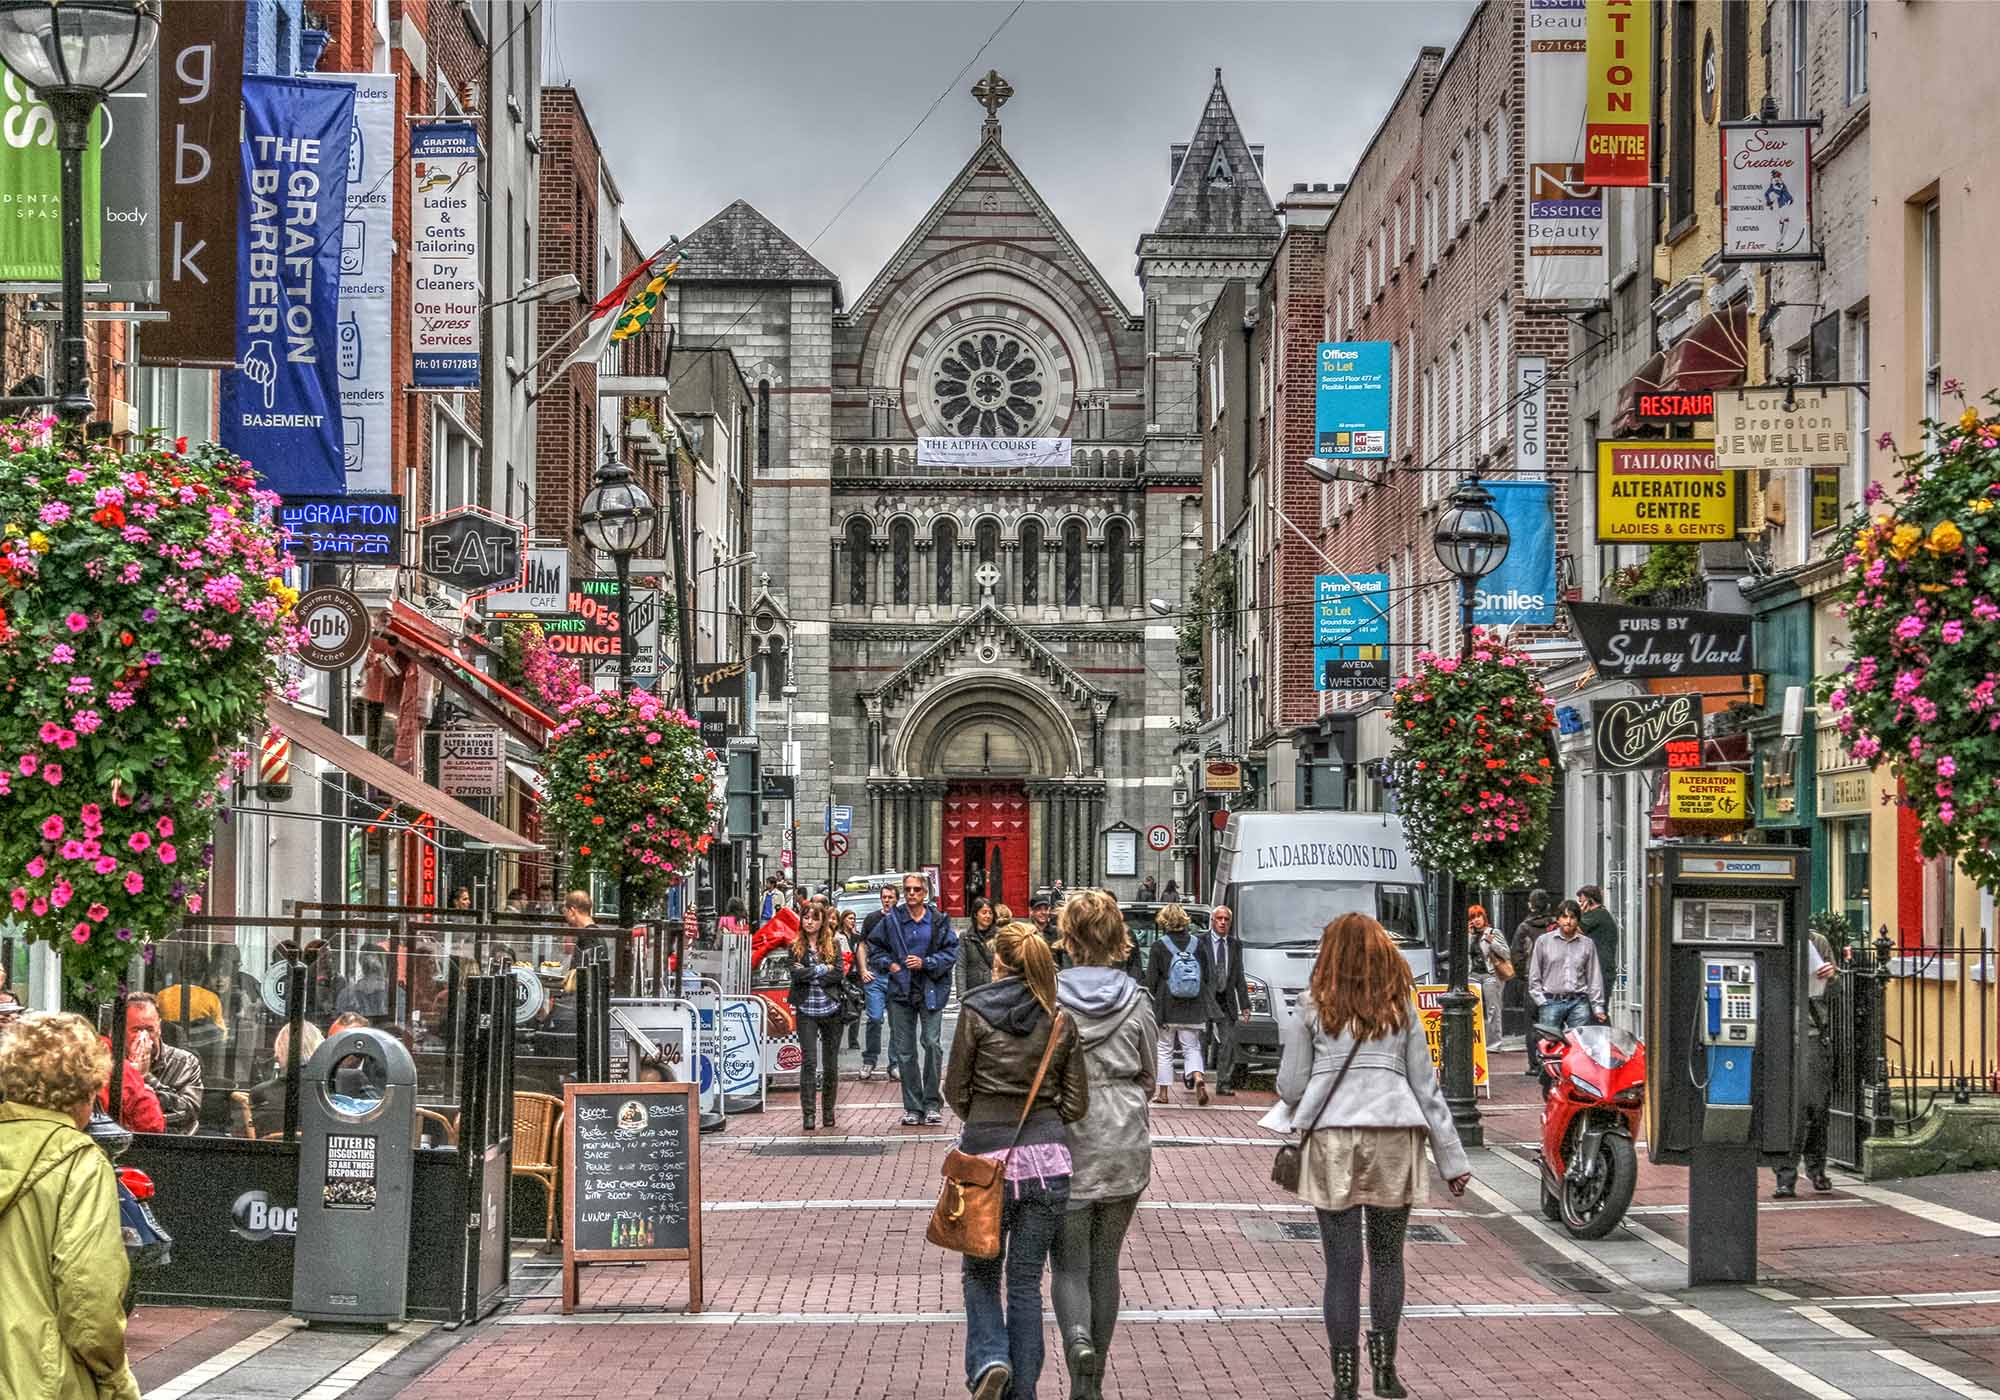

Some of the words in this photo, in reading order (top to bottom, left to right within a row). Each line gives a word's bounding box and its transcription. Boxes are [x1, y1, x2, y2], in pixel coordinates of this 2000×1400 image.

[1606, 0, 1632, 112] TION
[423, 138, 466, 147] GRAFTON
[1590, 134, 1645, 155] CENTRE
[1745, 129, 1787, 152] Sew
[255, 135, 321, 164] THE
[414, 146, 476, 155] ALTERATIONS
[1734, 150, 1794, 170] Creative
[424, 197, 467, 208] Ladies
[16, 209, 58, 218] SPAS
[1531, 202, 1601, 217] Essence
[106, 207, 148, 226] body
[440, 212, 451, 223] &
[425, 226, 465, 238] Gents
[1529, 224, 1600, 240] Beauty
[248, 169, 280, 333] BARBER
[416, 241, 475, 255] Tailoring
[285, 169, 320, 364] GRAFTON
[433, 264, 458, 278] Dry
[416, 279, 475, 290] Cleaners
[414, 303, 441, 314] One
[445, 303, 477, 314] Hour
[420, 317, 471, 331] Xpress
[420, 334, 472, 345] Services
[1322, 349, 1359, 360] Offices
[415, 359, 428, 368] Ph:
[430, 359, 441, 368] 01
[442, 359, 477, 368] 6717813
[1323, 362, 1335, 372] To
[1337, 362, 1353, 371] Let
[1639, 395, 1713, 416] RESTAUR
[1745, 396, 1821, 410] Loran
[242, 414, 324, 427] BASEMENT
[1734, 415, 1832, 430] Brereton
[924, 440, 948, 450] THE
[950, 440, 987, 450] ALPHA
[991, 440, 1037, 450] COURSE
[1717, 432, 1849, 454] JEWELLER
[1620, 453, 1714, 470] TAILORING
[1611, 480, 1727, 498] ALTERATIONS
[304, 503, 397, 525] GRAFTON
[1635, 502, 1701, 519] CENTRE
[1611, 523, 1659, 534] LADIES
[1664, 523, 1673, 534] &
[1679, 523, 1726, 535] GENTS
[428, 530, 513, 577] EAT
[582, 582, 620, 595] WINE
[1321, 582, 1350, 592] Prime
[1353, 582, 1381, 592] Retail
[1473, 589, 1544, 610] Smiles
[1321, 607, 1333, 616] To
[1335, 607, 1351, 616] Let
[309, 614, 346, 639] gbk
[1619, 618, 1662, 631] FURS
[1666, 618, 1689, 630] BY
[311, 650, 346, 661] kitchen
[1600, 634, 1685, 674] Sydney
[1689, 633, 1747, 663] Vard
[1342, 661, 1374, 669] AVEDA
[1329, 677, 1388, 688] WHETSTONE
[1598, 698, 1691, 767] Cave
[444, 739, 494, 747] ALTERATIONS
[1668, 754, 1700, 767] BAR
[1678, 777, 1737, 785] ALTERATION
[456, 787, 492, 795] 6717813
[1153, 831, 1166, 842] 50
[1372, 847, 1398, 870] LTD
[328, 1136, 362, 1149] LITTER
[364, 1138, 376, 1149] IS
[328, 1149, 375, 1159] DISGUSTING
[339, 1161, 351, 1169] ARE
[327, 1169, 374, 1178] RESPONSIBLE
[581, 1211, 611, 1222] LUNCH
